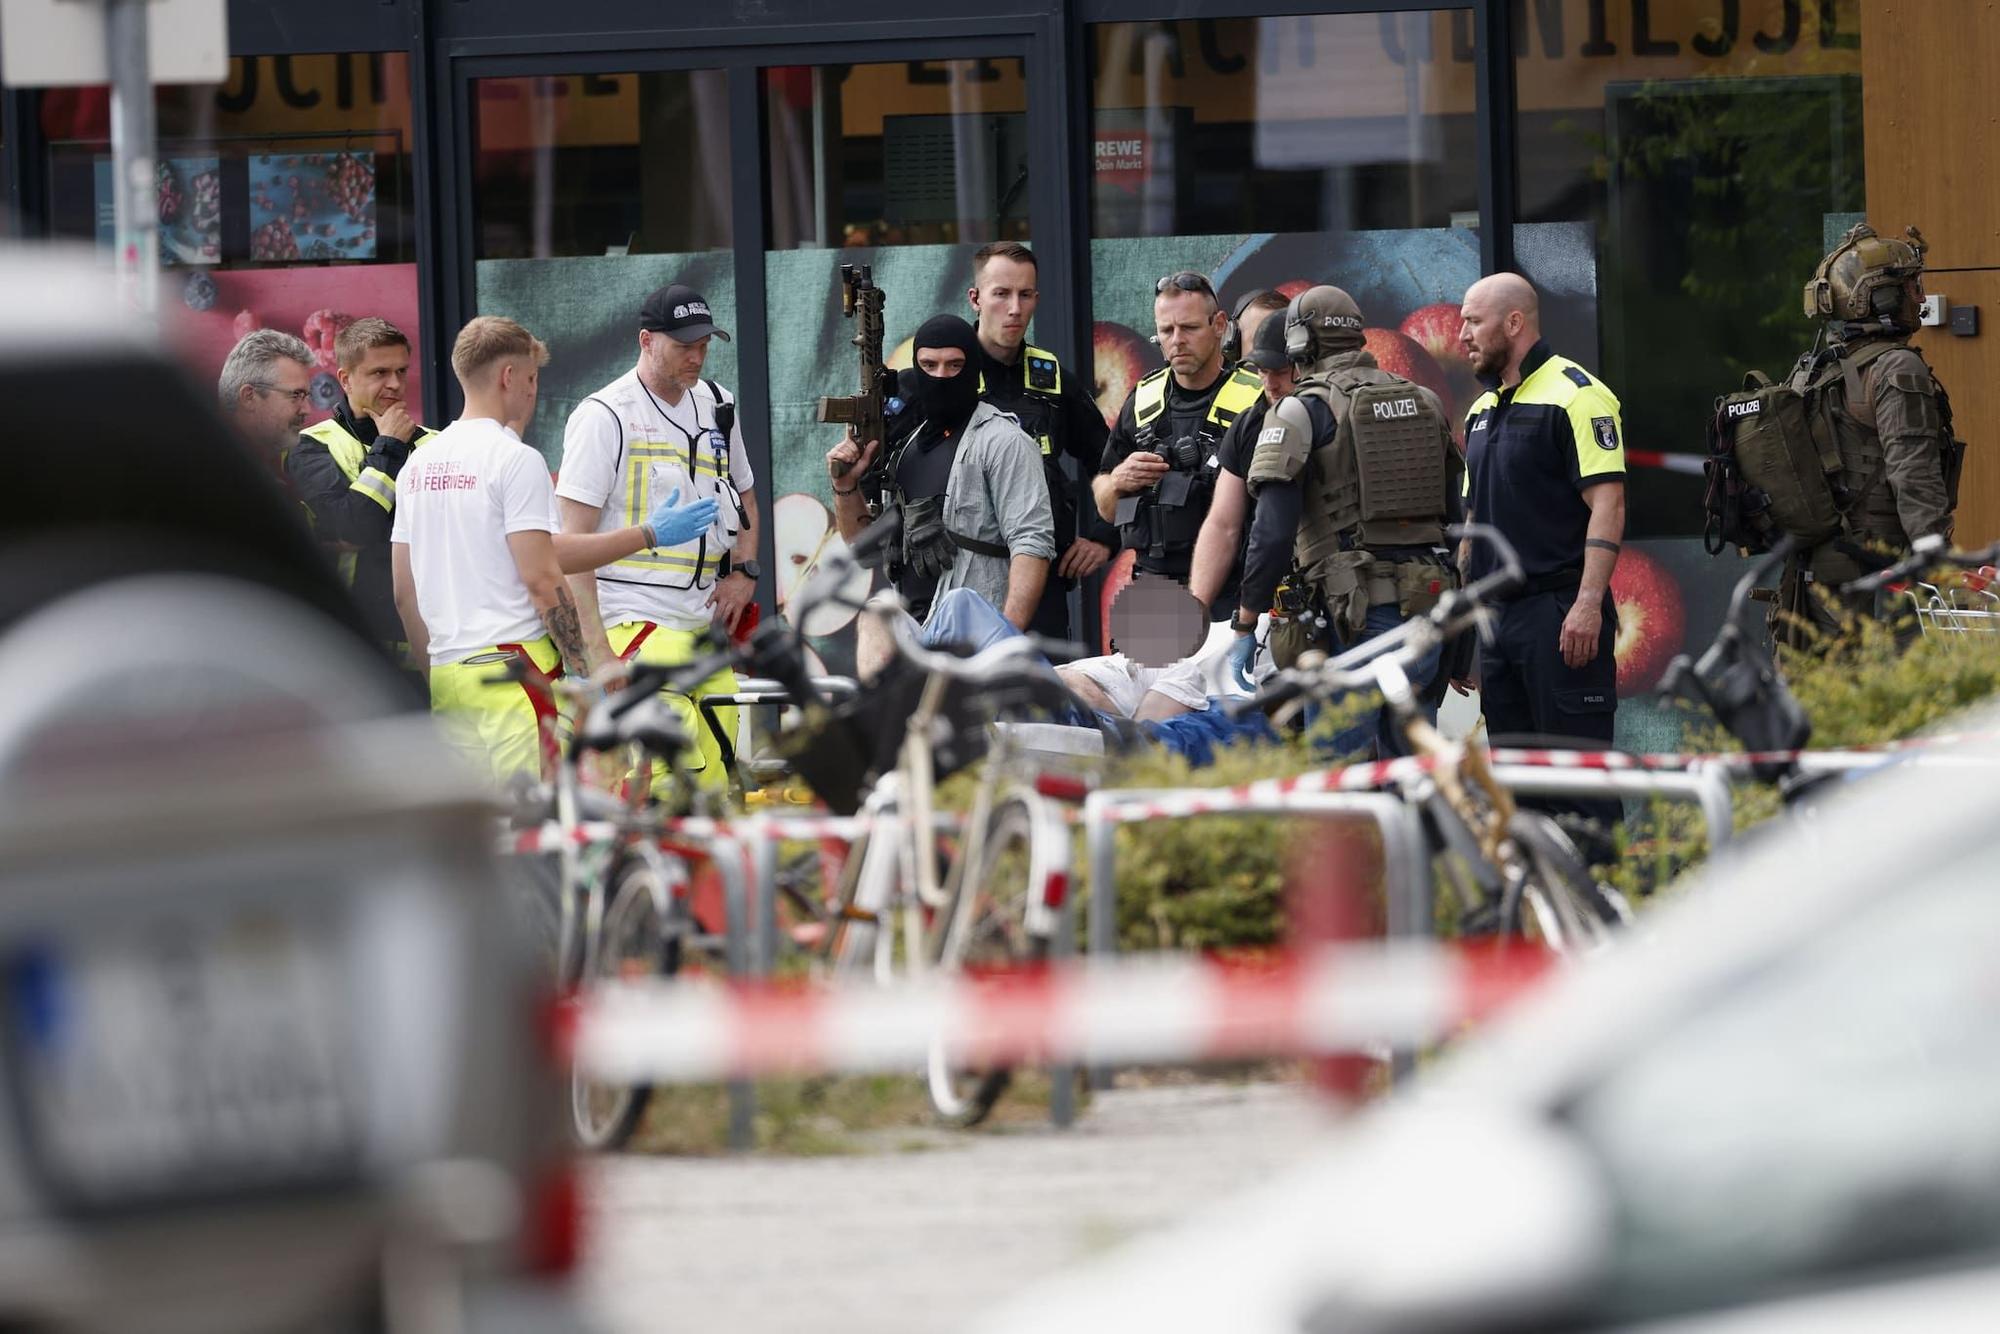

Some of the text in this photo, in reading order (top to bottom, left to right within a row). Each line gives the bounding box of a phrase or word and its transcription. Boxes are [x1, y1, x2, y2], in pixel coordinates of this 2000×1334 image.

[1095, 141, 1142, 156] REWE
[1116, 159, 1142, 170] Markt
[1372, 398, 1419, 419] POLIZEI
[1728, 399, 1760, 418] POLIZEI
